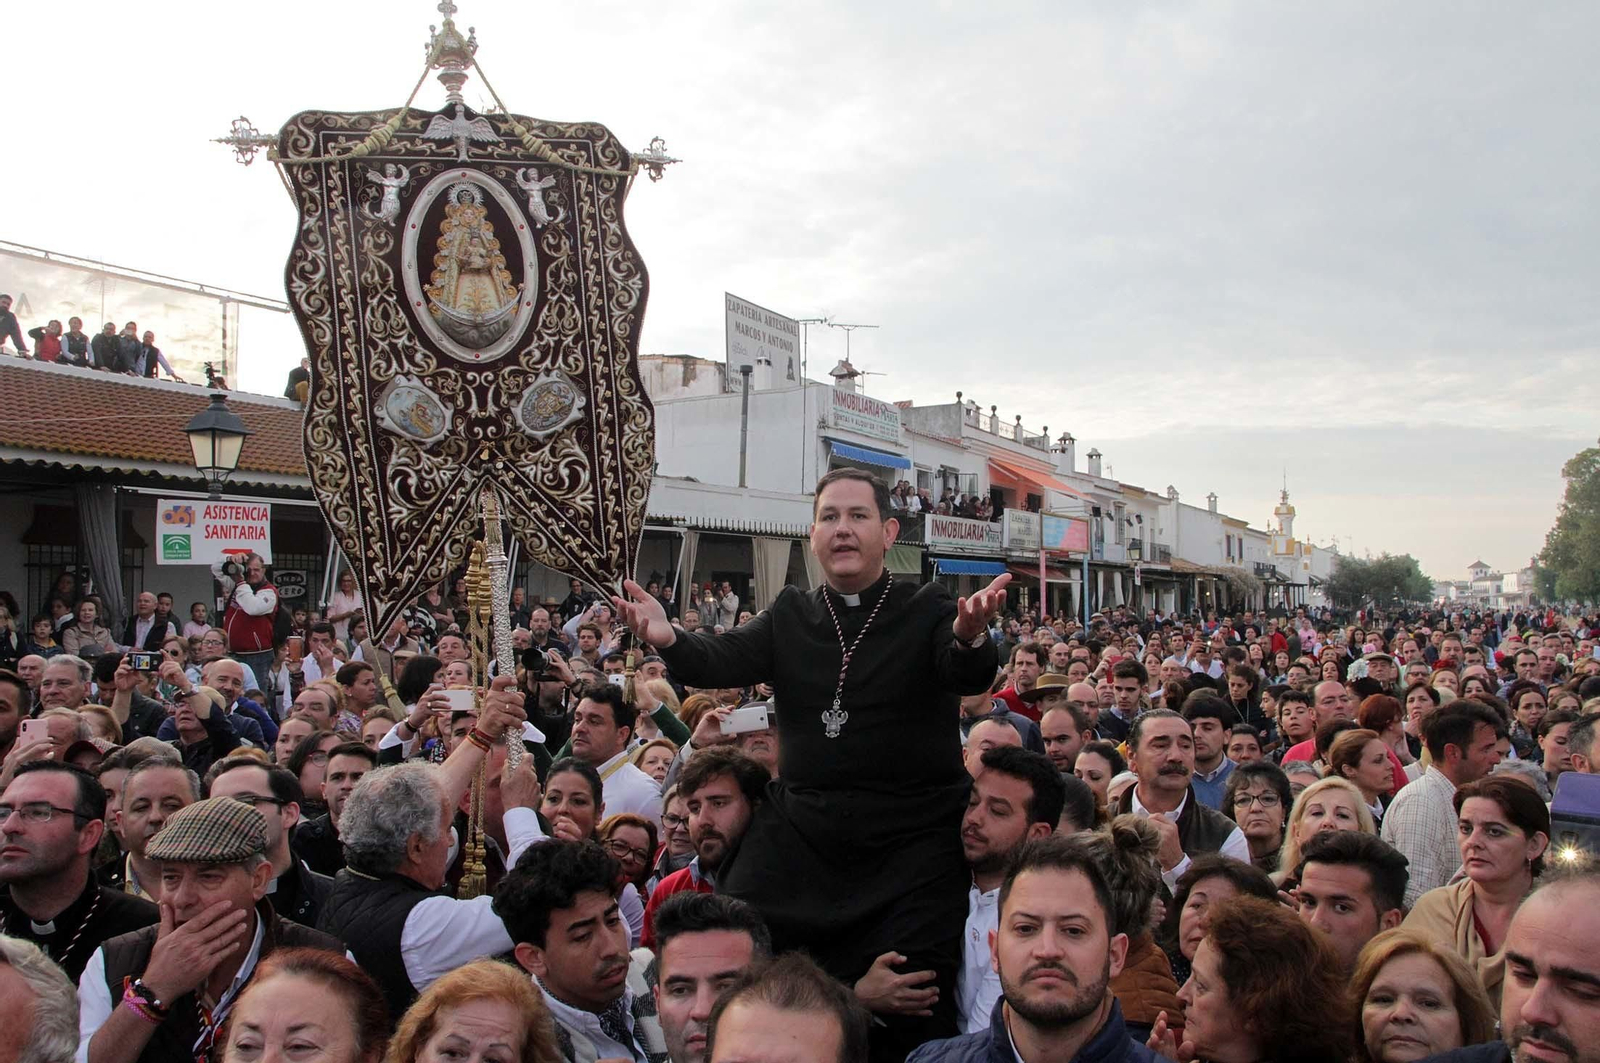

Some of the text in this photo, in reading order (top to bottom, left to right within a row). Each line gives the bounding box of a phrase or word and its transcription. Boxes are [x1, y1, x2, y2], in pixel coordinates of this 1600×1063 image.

[727, 299, 798, 337] ZAPATERIA ARTESANAL
[735, 320, 761, 341] MARCOS
[761, 331, 767, 343] Y
[768, 334, 794, 353] ANTONIO
[832, 388, 880, 419] INMOBILIARIA
[203, 505, 269, 522] ASISTENCIA
[204, 524, 267, 541] SANITARIA
[931, 518, 984, 542] INMOBILIARIA
[276, 575, 302, 583] ONDA
[280, 587, 302, 597] CERO
